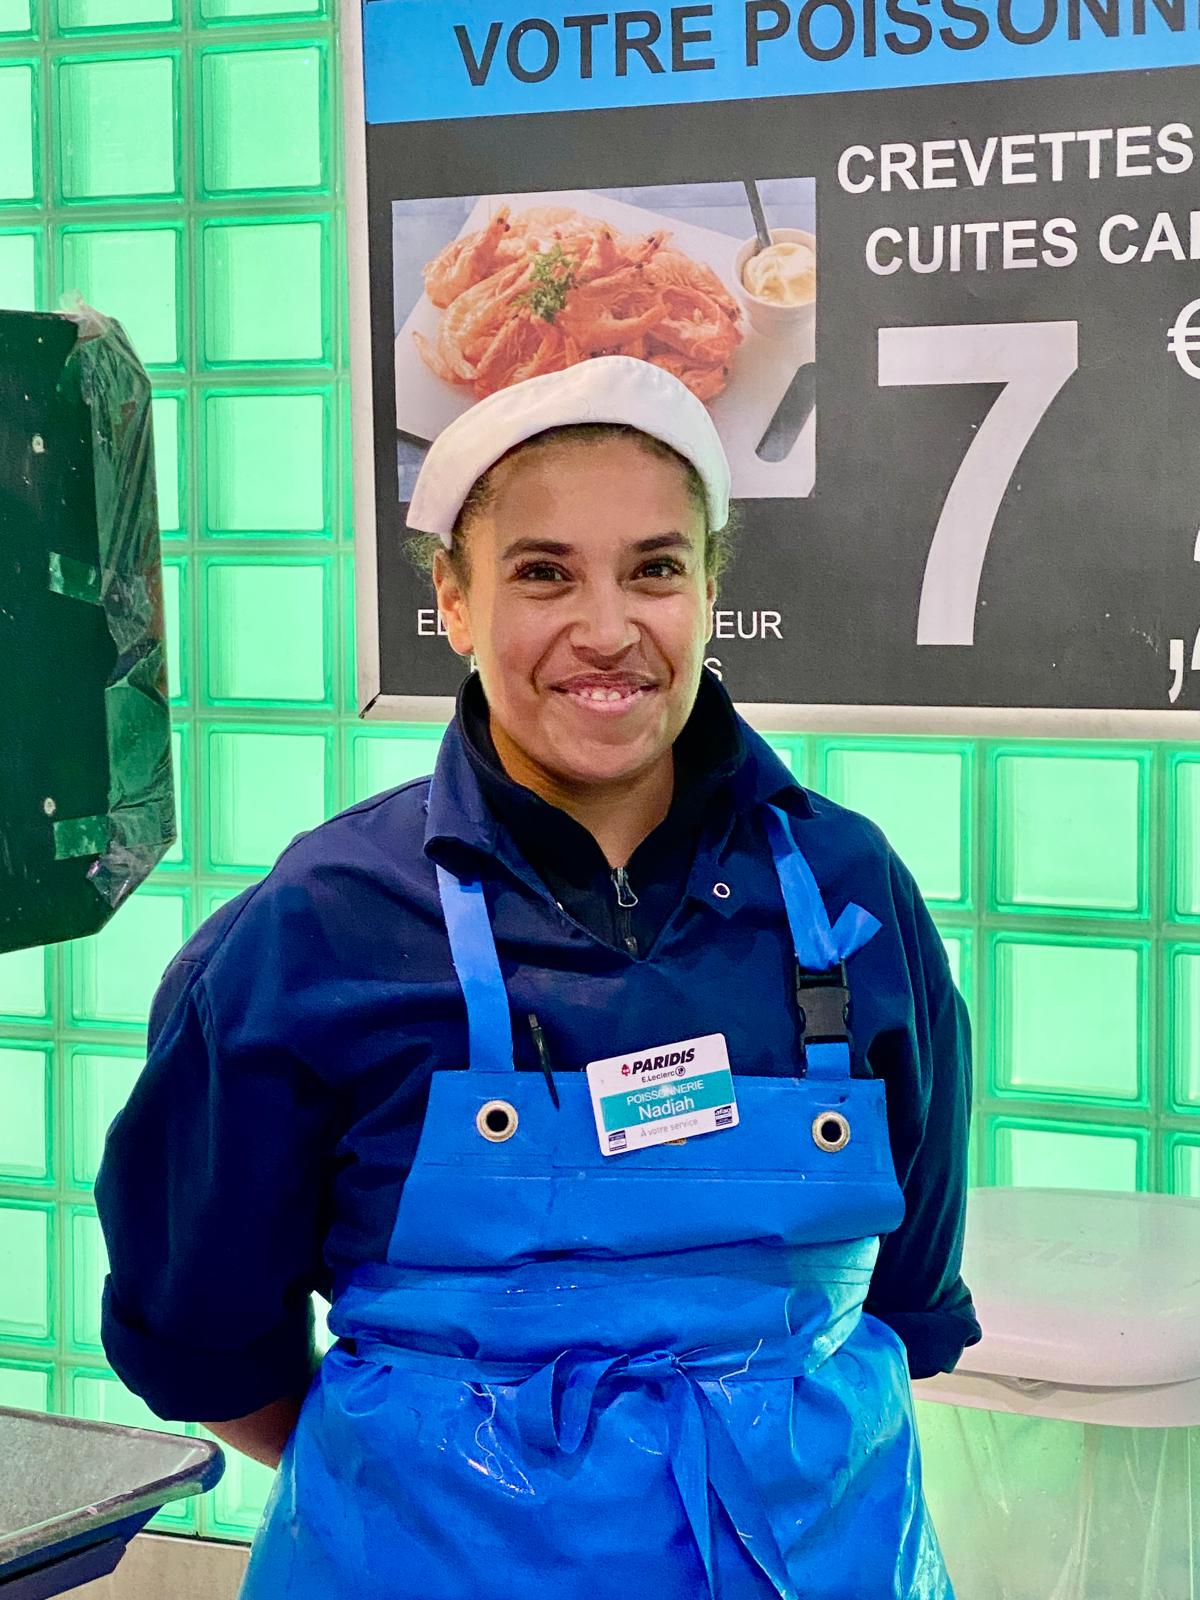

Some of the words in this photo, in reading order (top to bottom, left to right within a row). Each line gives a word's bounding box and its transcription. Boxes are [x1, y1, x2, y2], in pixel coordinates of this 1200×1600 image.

[453, 5, 716, 87] VOTRE
[745, 0, 1200, 66] POISSONN
[837, 123, 1194, 194] CREVETTES
[866, 218, 1078, 276] CUITES
[878, 320, 1078, 647] 7
[715, 610, 784, 639] EUR
[632, 1048, 695, 1074] PARIDIS
[639, 1097, 694, 1120] Nadjah
